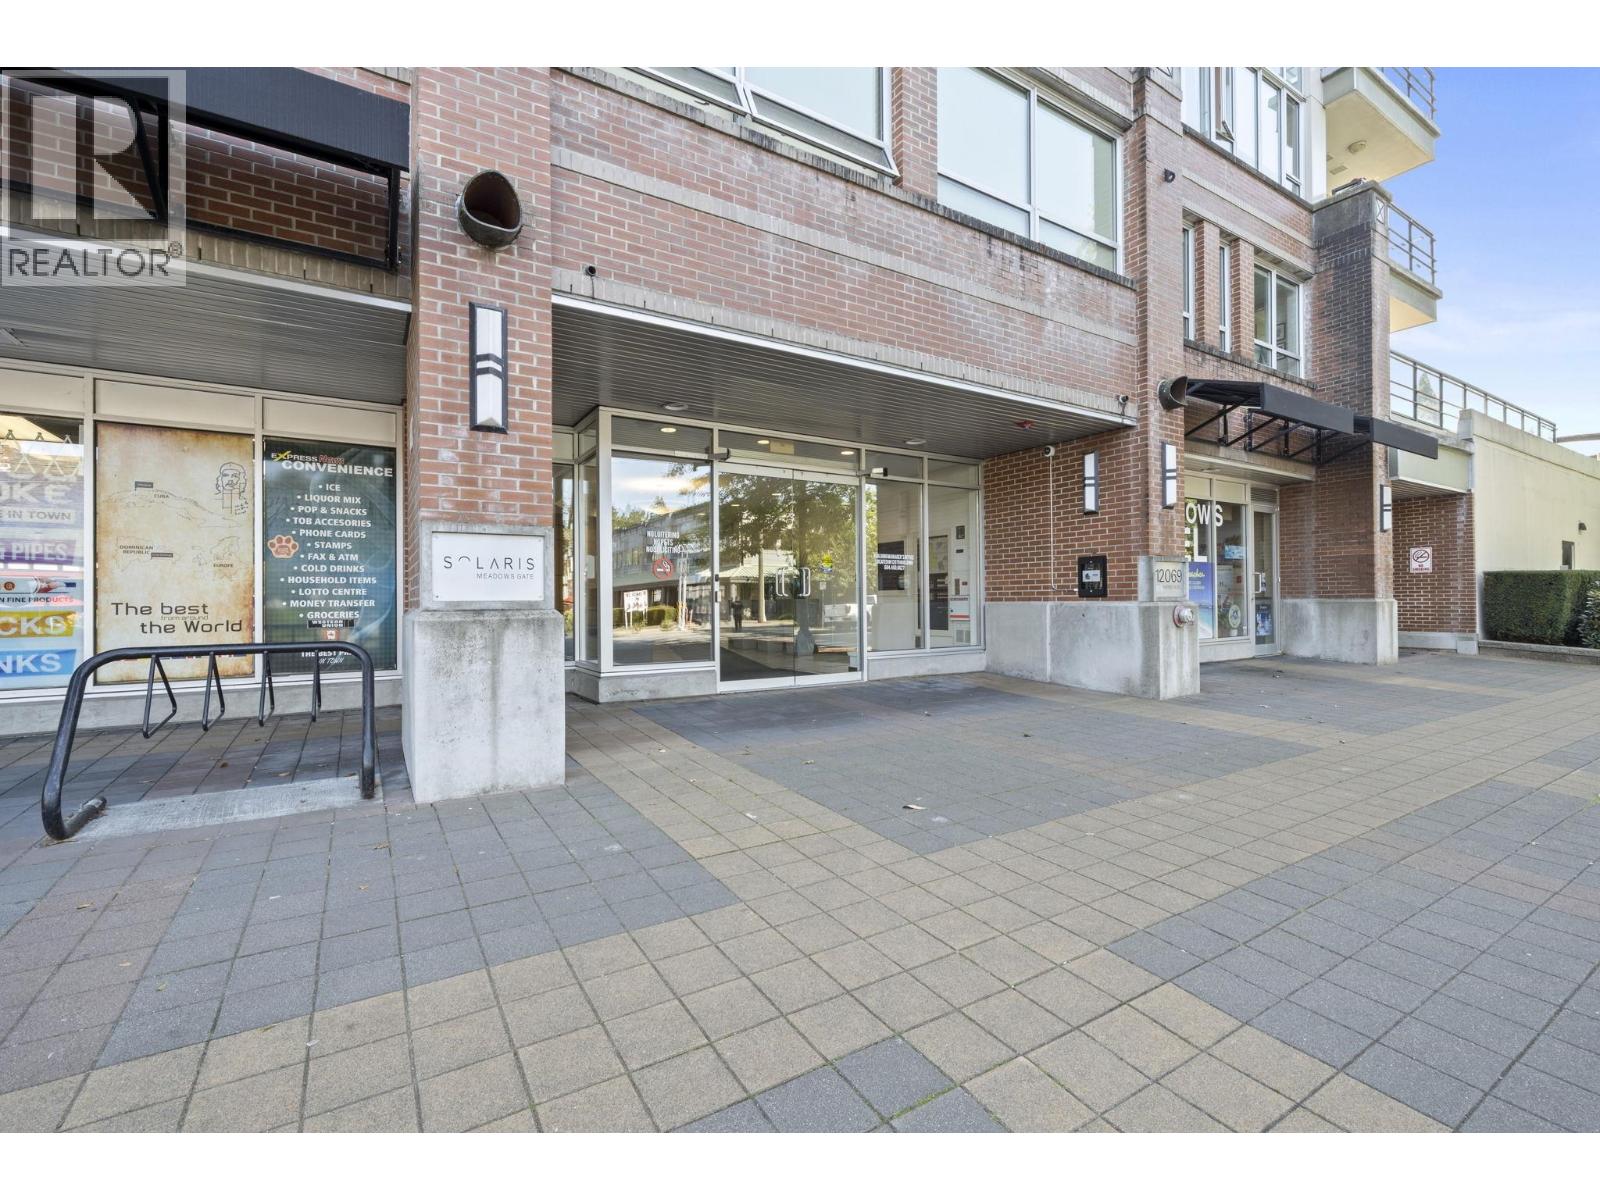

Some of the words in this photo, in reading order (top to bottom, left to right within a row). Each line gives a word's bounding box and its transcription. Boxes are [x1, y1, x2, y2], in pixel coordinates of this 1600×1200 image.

[271, 451, 318, 461] EXPRESS
[281, 460, 393, 477] CONVENIENCE
[304, 494, 340, 503] LIQUOR
[320, 506, 328, 514] &
[330, 507, 367, 515] SNACKS
[29, 511, 72, 520] TOWN
[293, 517, 312, 525] TOB
[314, 518, 372, 527] ACCESORIES
[299, 529, 332, 537] PHONE
[335, 530, 367, 539] CARDS
[314, 541, 352, 549] STAMPS
[11, 542, 68, 561] PIPES
[329, 553, 336, 561] &
[338, 553, 359, 561] ATM
[443, 555, 535, 571] SOLARIS
[301, 564, 327, 572] COLD
[330, 565, 365, 573] DRINKS
[287, 576, 347, 584] HOUSEHOLD
[349, 576, 377, 584] ITEMS
[476, 572, 515, 580] MEADOWS
[1154, 568, 1183, 583] 12069
[298, 588, 330, 596] LOTTO
[332, 588, 367, 596] CENTRE
[290, 600, 326, 608] MONEY
[329, 599, 375, 607] TRANSFER
[111, 602, 152, 615] The
[160, 602, 209, 615] best
[307, 611, 360, 619] GROCERIES
[140, 620, 176, 634] the
[184, 619, 243, 633] World
